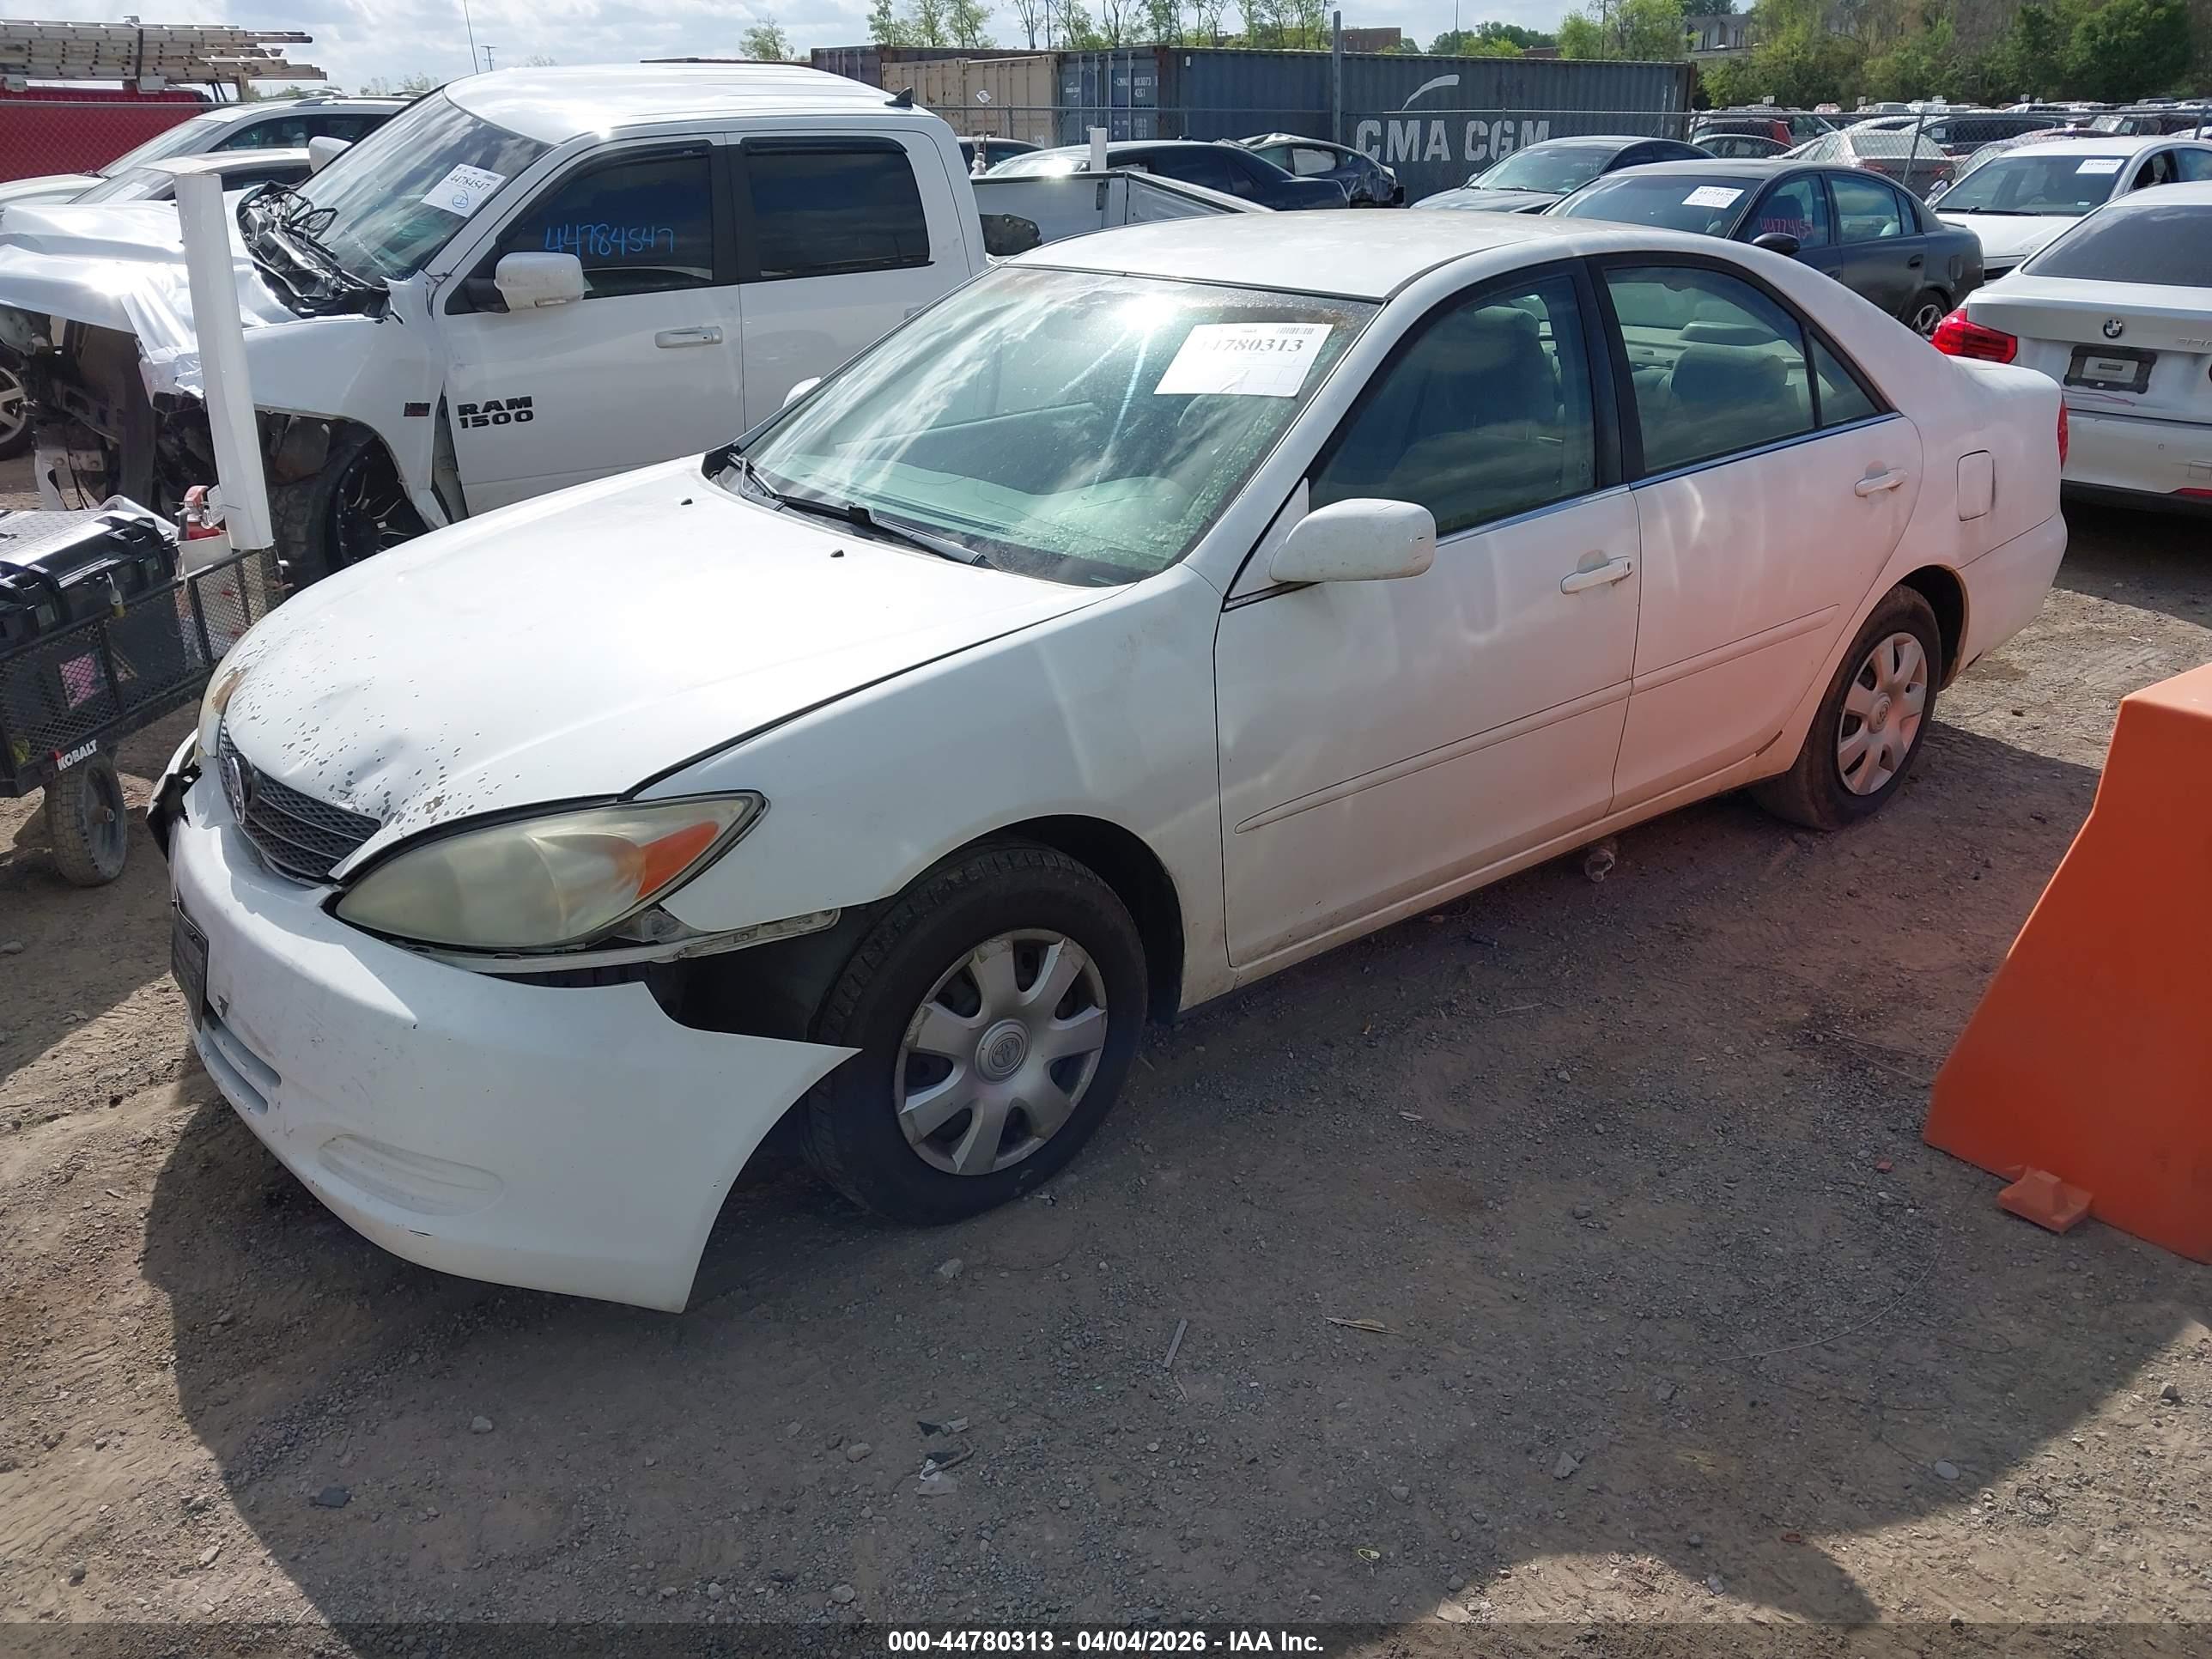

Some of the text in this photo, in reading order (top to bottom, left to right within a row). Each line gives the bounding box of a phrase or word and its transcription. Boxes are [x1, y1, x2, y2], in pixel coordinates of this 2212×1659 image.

[1356, 119, 1551, 162] CMA CGM
[544, 223, 674, 257] 44784547
[1202, 338, 1305, 353] 4780313
[457, 395, 533, 416] RAM
[459, 409, 534, 429] 1500
[56, 738, 98, 771] KOBALT
